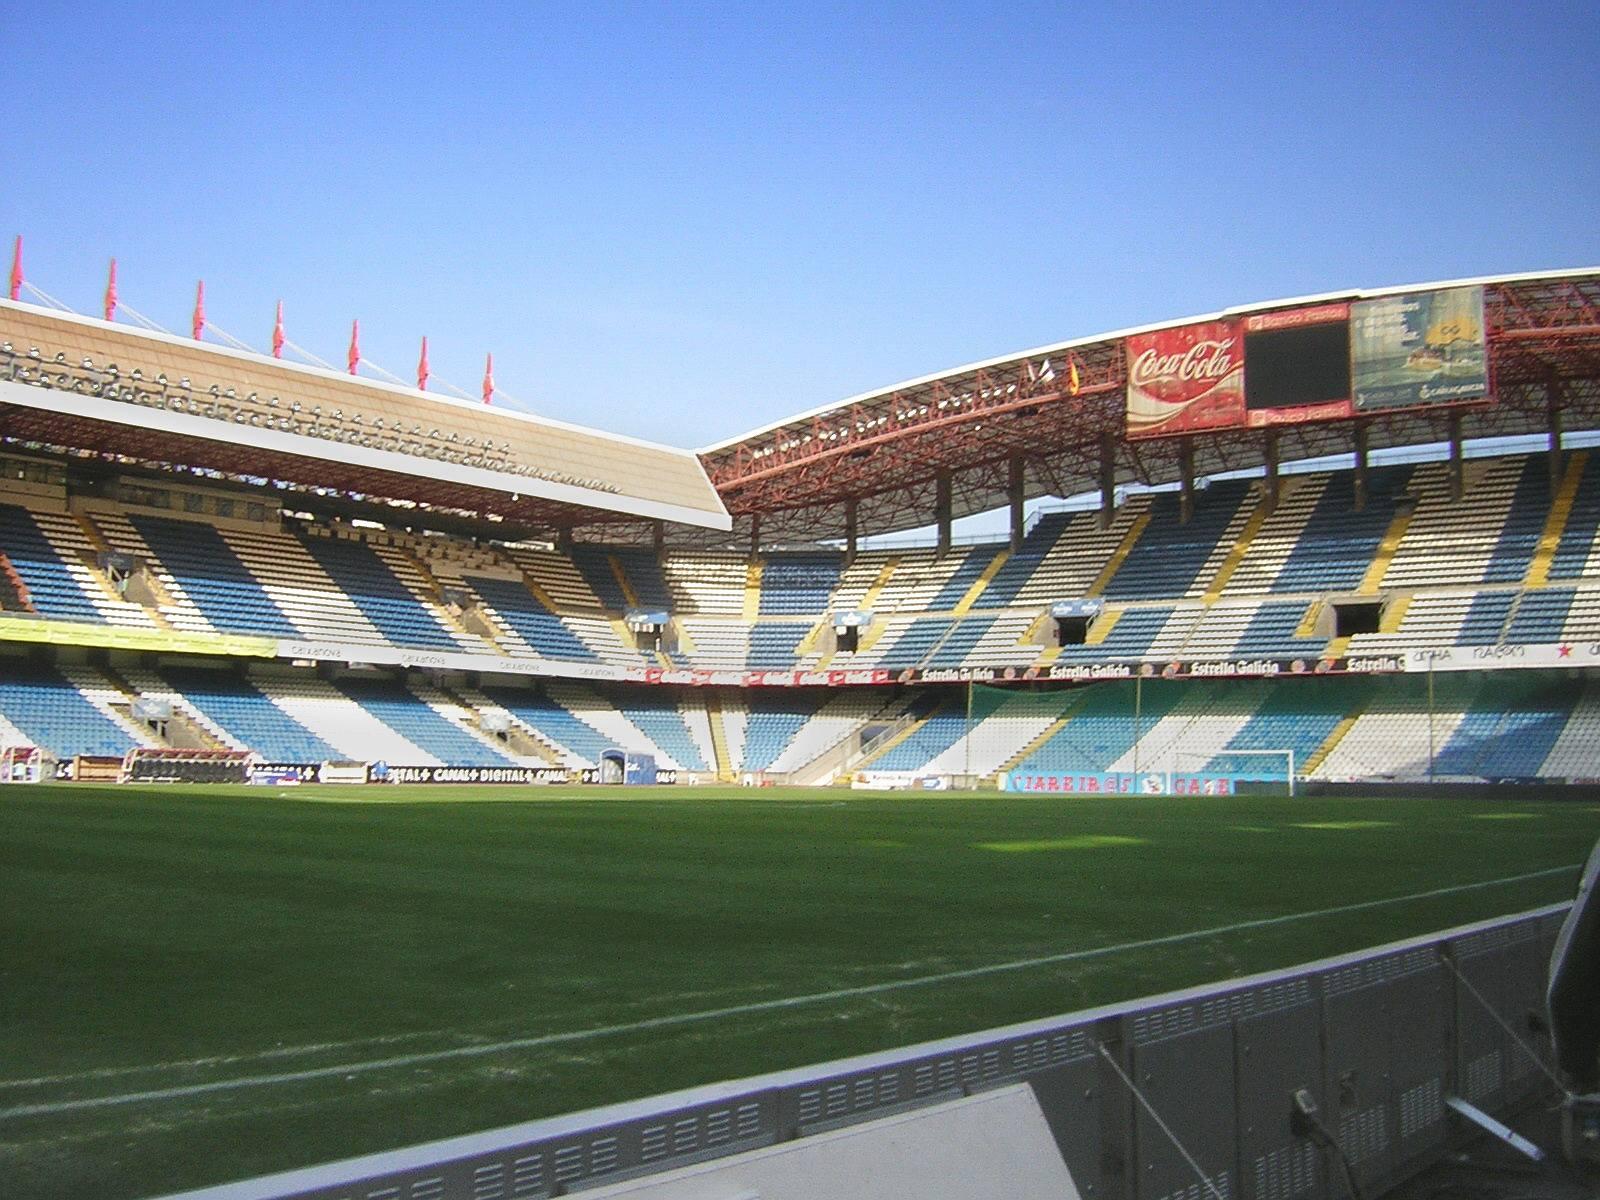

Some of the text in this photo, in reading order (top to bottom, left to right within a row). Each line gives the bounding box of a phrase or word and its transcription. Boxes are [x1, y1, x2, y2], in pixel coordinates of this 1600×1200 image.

[1132, 337, 1236, 385] Coca-Cola
[1050, 664, 1130, 680] Estrella Galicia
[1191, 660, 1280, 676] Estrella Galicia
[1346, 656, 1396, 672] Estrella
[922, 668, 959, 682] Estrella
[433, 768, 479, 782] CANAL+
[480, 769, 534, 782] DIGITAL+
